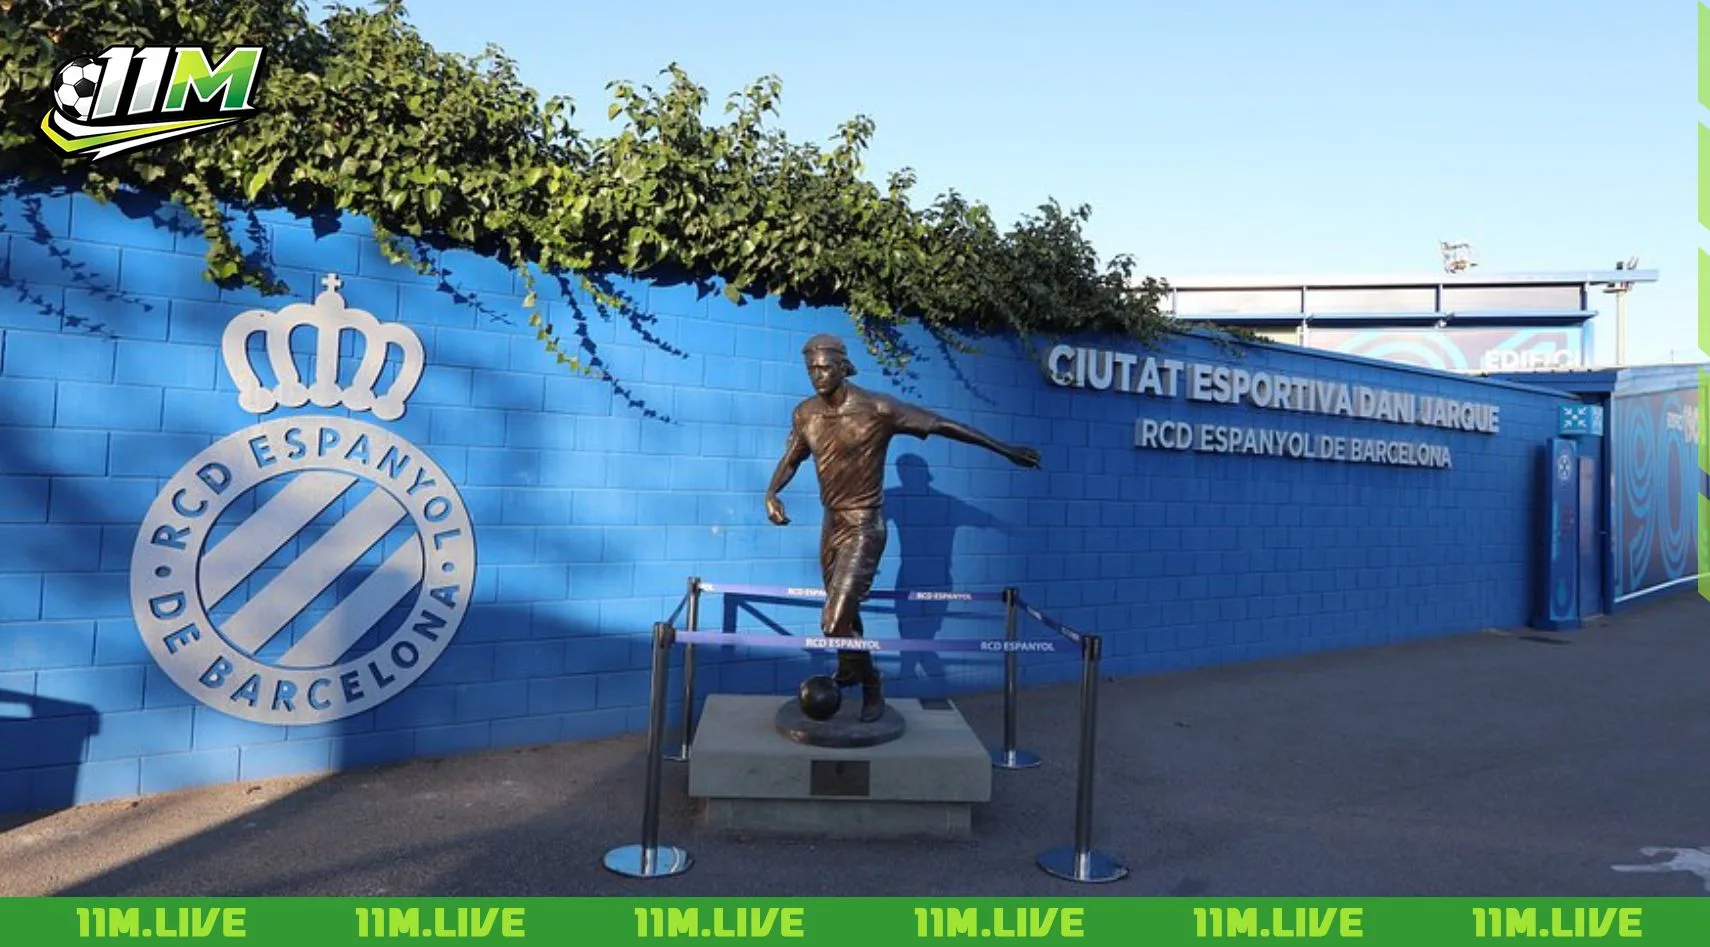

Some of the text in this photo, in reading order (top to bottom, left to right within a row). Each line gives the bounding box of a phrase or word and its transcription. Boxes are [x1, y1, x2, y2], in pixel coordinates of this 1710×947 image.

[1046, 344, 1500, 433] CIUTAT ESPORTIVA DANI JARQUE
[1140, 418, 1452, 468] RCD ESPANYOL DE BARCELONA
[151, 427, 461, 552] RCD ESPANYOL
[149, 582, 460, 712] DE BARCELONA
[806, 637, 880, 651] RCD ESPANYOL
[980, 641, 1054, 652] RCD ESPANYOL
